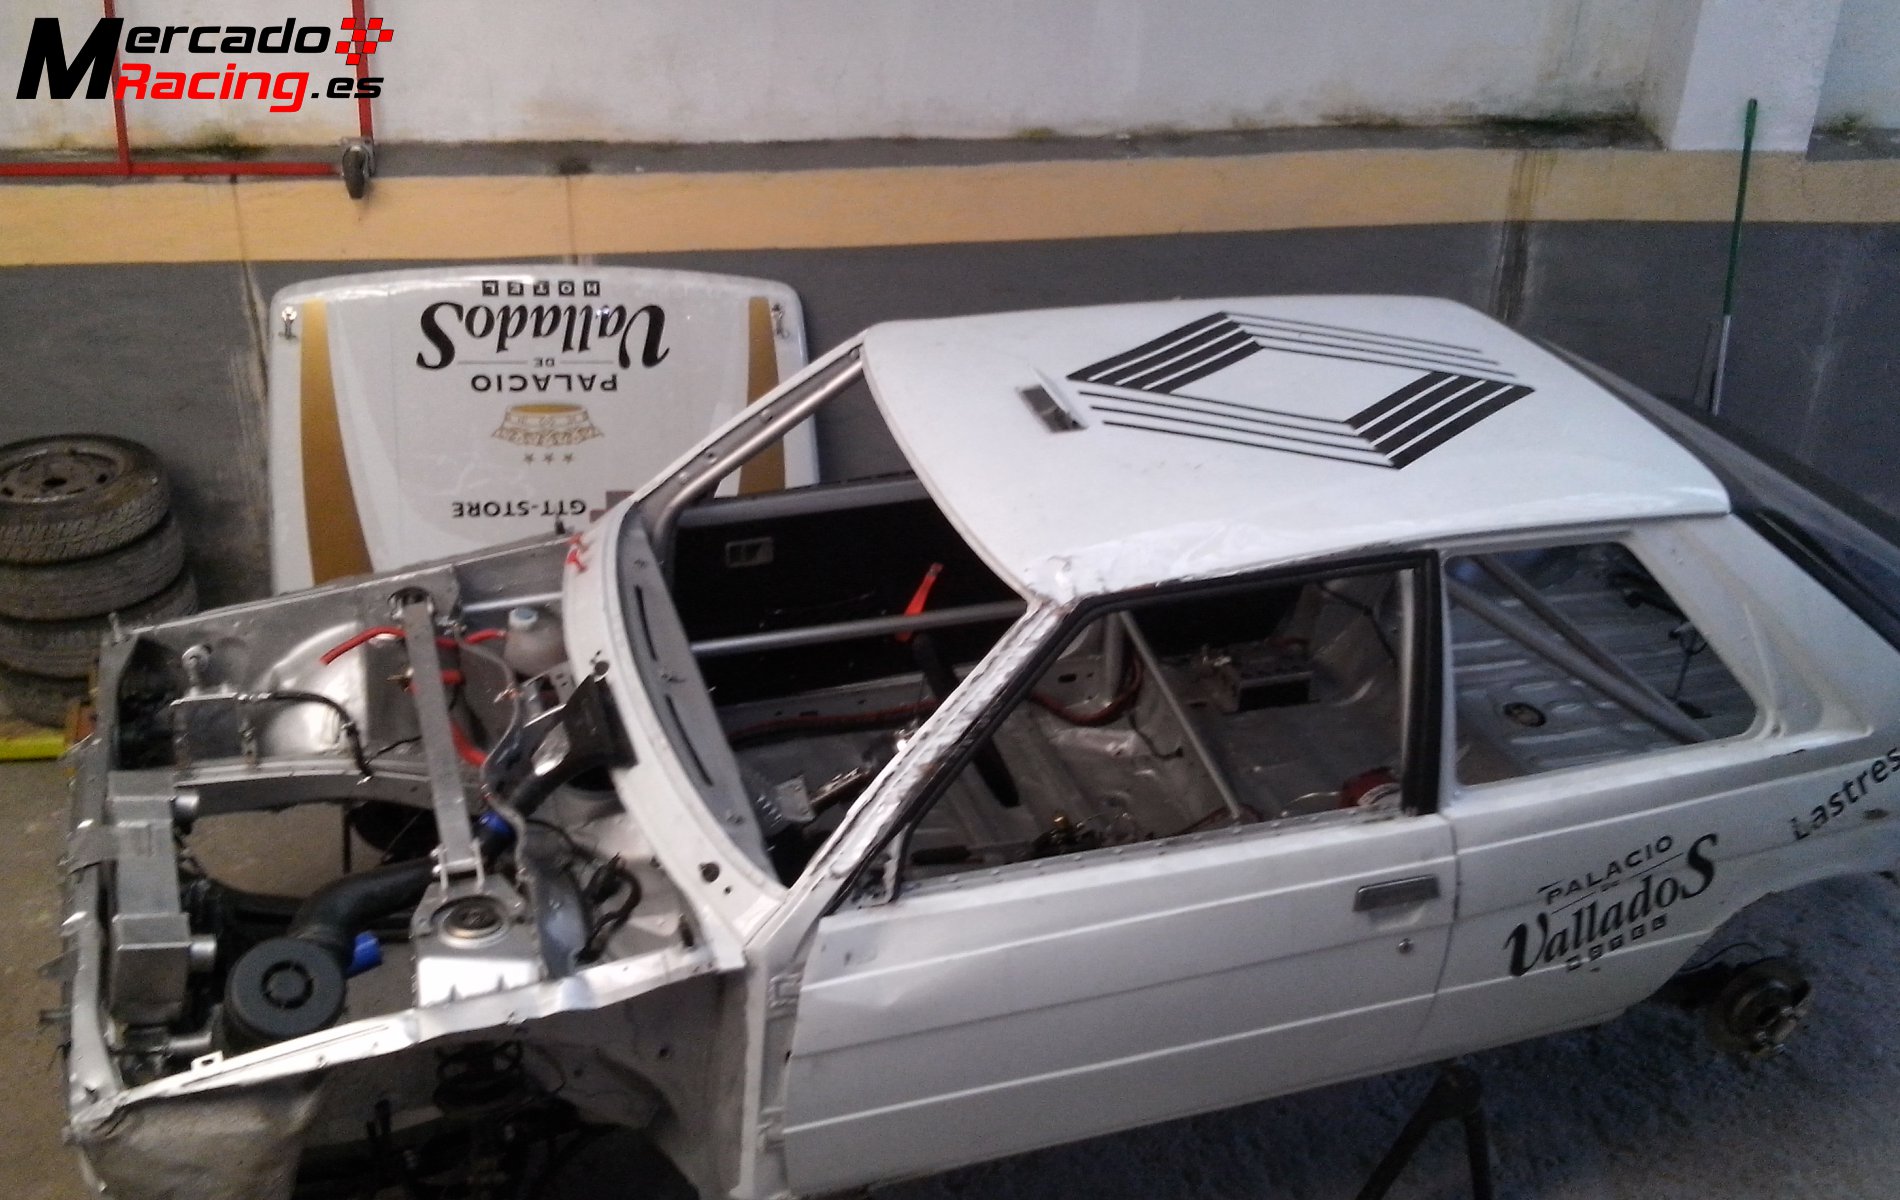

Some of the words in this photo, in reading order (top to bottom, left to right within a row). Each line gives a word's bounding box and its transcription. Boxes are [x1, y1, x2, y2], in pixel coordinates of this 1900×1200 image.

[482, 280, 600, 297] HOTEL
[534, 356, 555, 368] DE
[471, 374, 618, 392] PALACIO
[452, 499, 587, 518] GTT-STORE
[1789, 747, 1900, 840] Lastres
[1538, 834, 1673, 904] PALACIO
